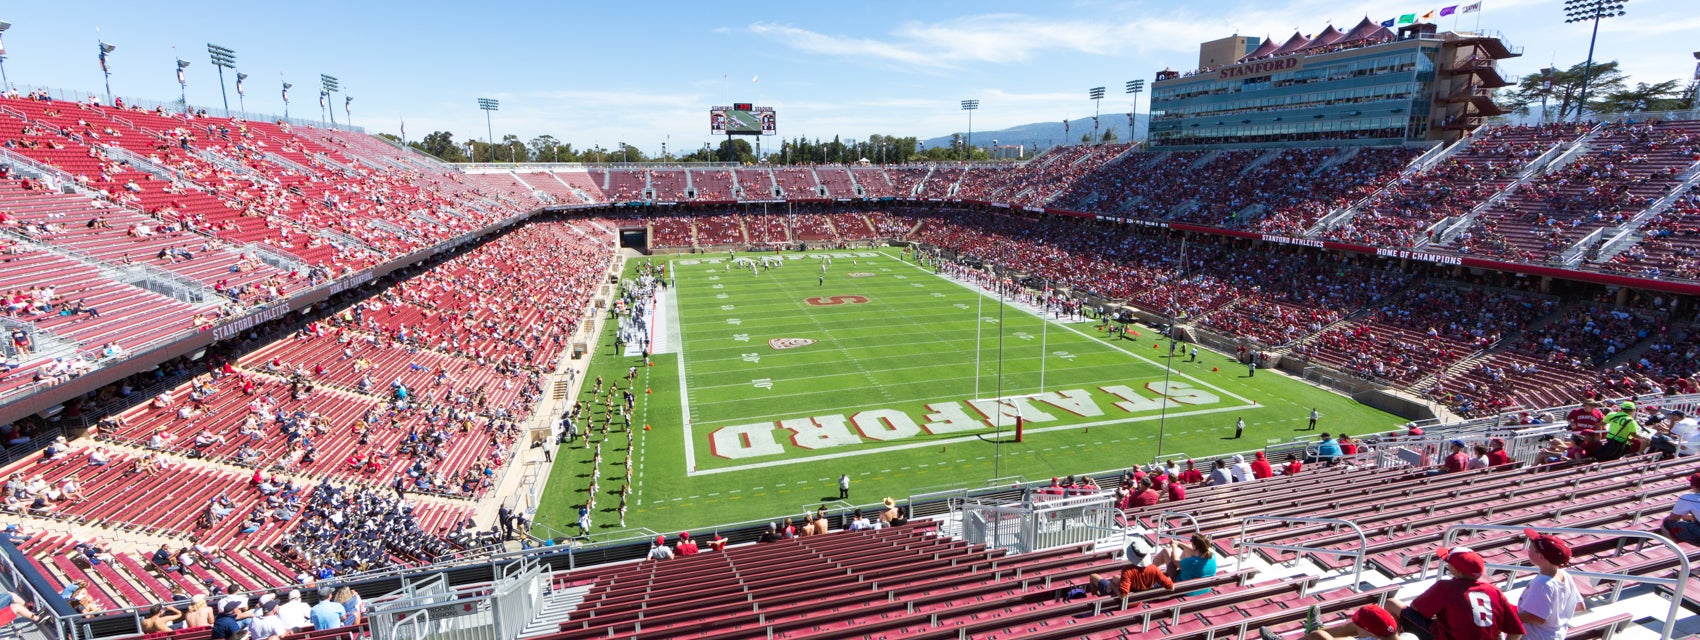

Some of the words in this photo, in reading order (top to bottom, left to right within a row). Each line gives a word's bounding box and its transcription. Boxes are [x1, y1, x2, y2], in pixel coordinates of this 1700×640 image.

[1220, 58, 1297, 78] STANFORD
[1261, 234, 1290, 244] STANFORD
[1291, 238, 1324, 248] ATHLETICS
[1376, 248, 1398, 257] HOME
[1400, 250, 1410, 259] OF
[1412, 252, 1462, 265] CHAMPIONS
[212, 316, 253, 340] STANFORD
[254, 303, 290, 323] ATHLETICS
[708, 381, 1220, 459] STANFORD
